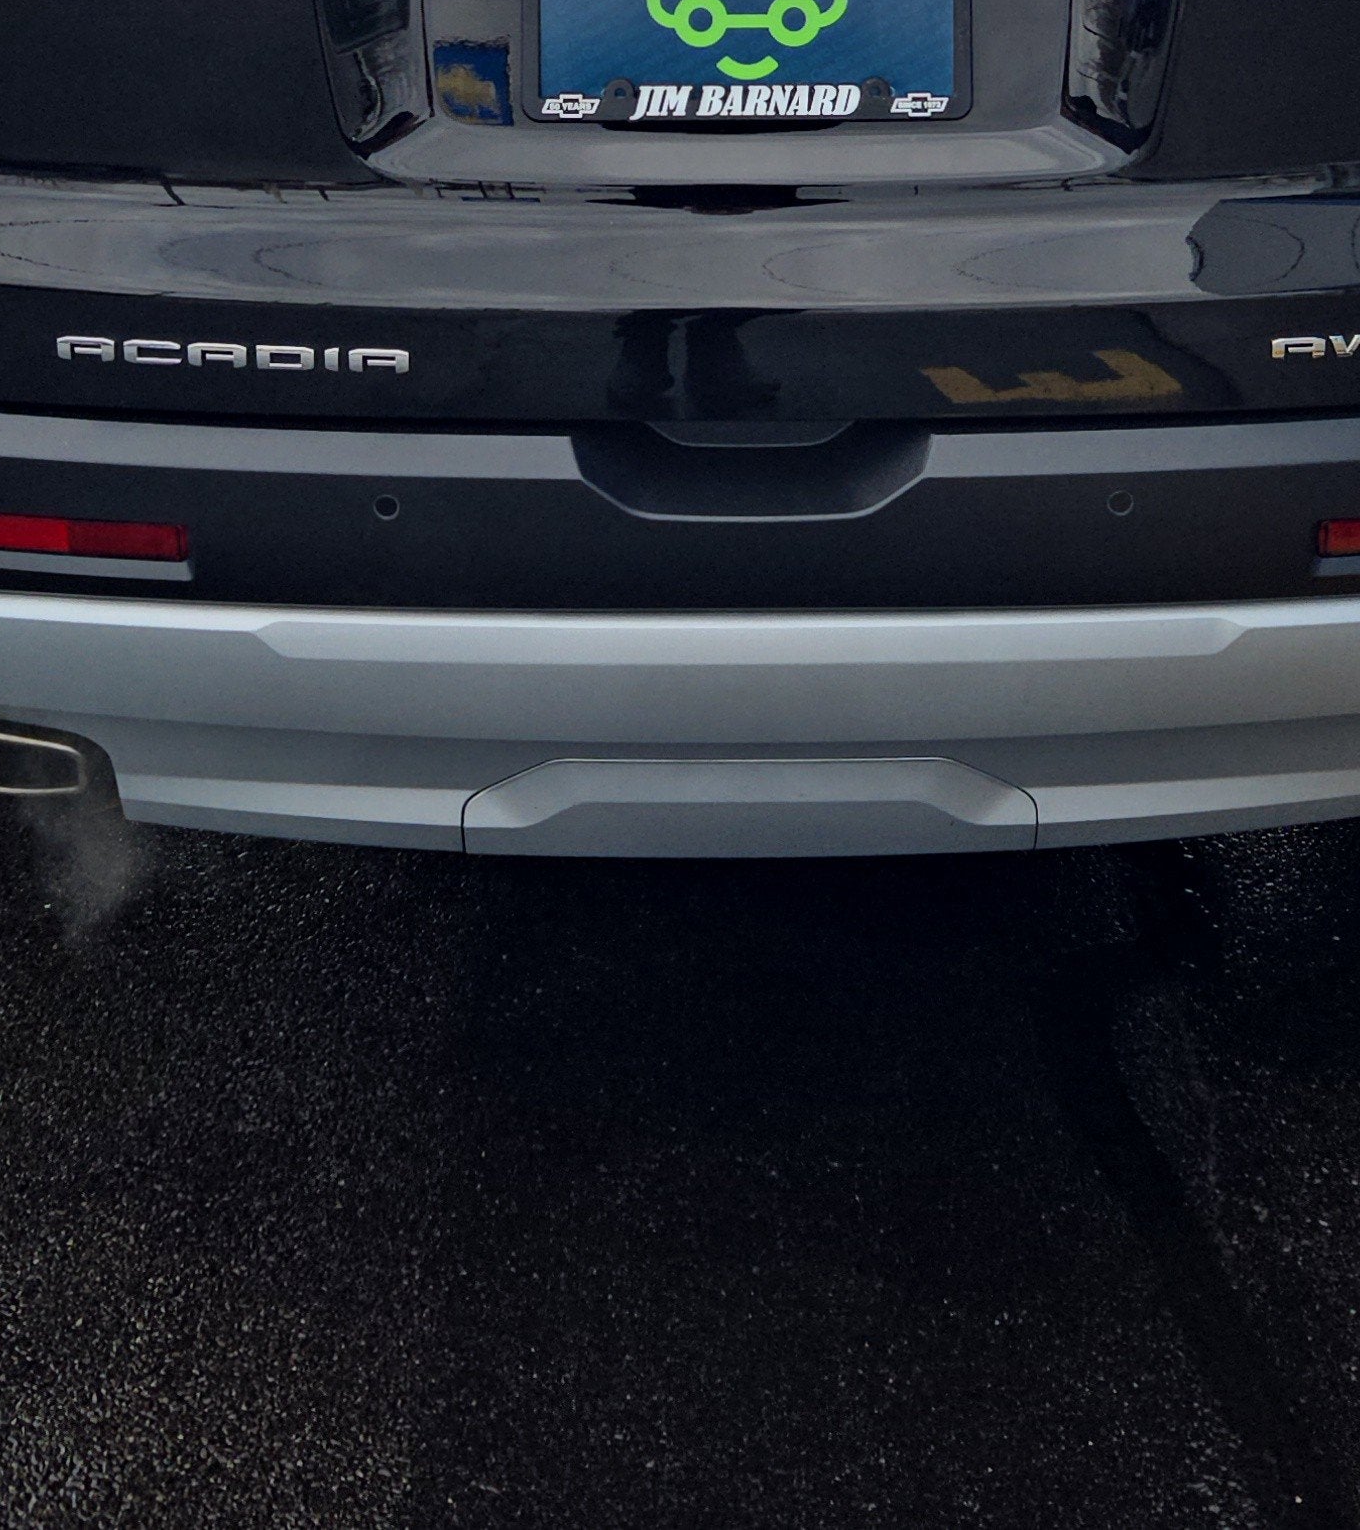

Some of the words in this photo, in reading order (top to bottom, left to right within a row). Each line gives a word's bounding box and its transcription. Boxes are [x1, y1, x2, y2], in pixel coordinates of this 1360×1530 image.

[562, 102, 592, 111] YEARS
[628, 85, 693, 121] JIM
[696, 84, 862, 117] BARNARD
[897, 101, 923, 110] SINCE
[56, 334, 410, 374] ACADIA
